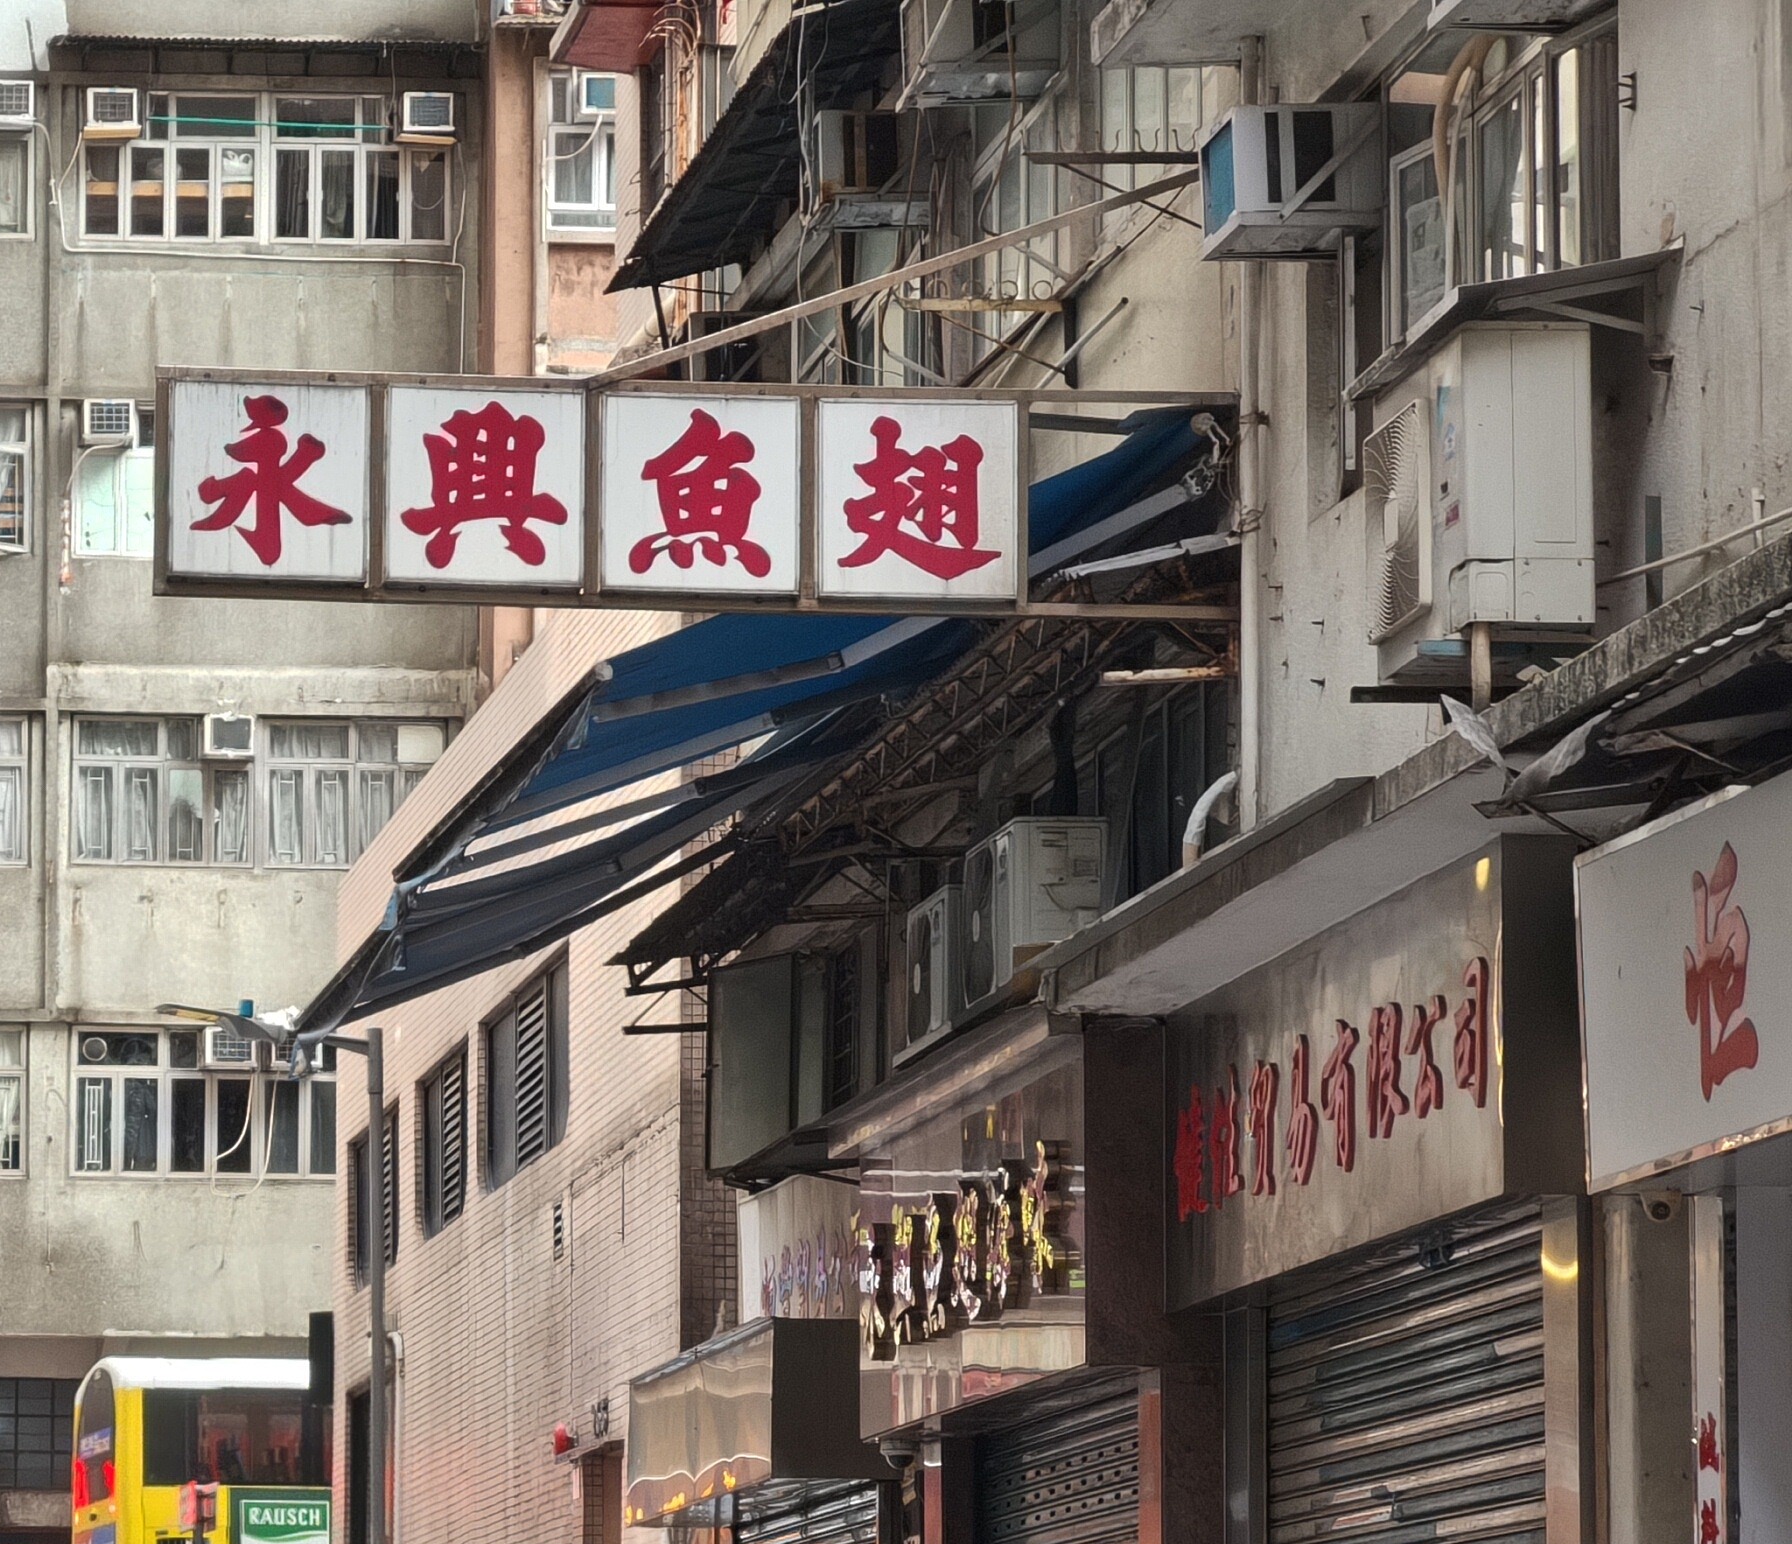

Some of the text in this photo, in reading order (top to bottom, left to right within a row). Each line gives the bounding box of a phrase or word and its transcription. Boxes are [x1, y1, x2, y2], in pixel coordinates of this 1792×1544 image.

[189, 393, 1003, 581] 永興魚翅
[248, 1506, 321, 1526] RAUSCH
